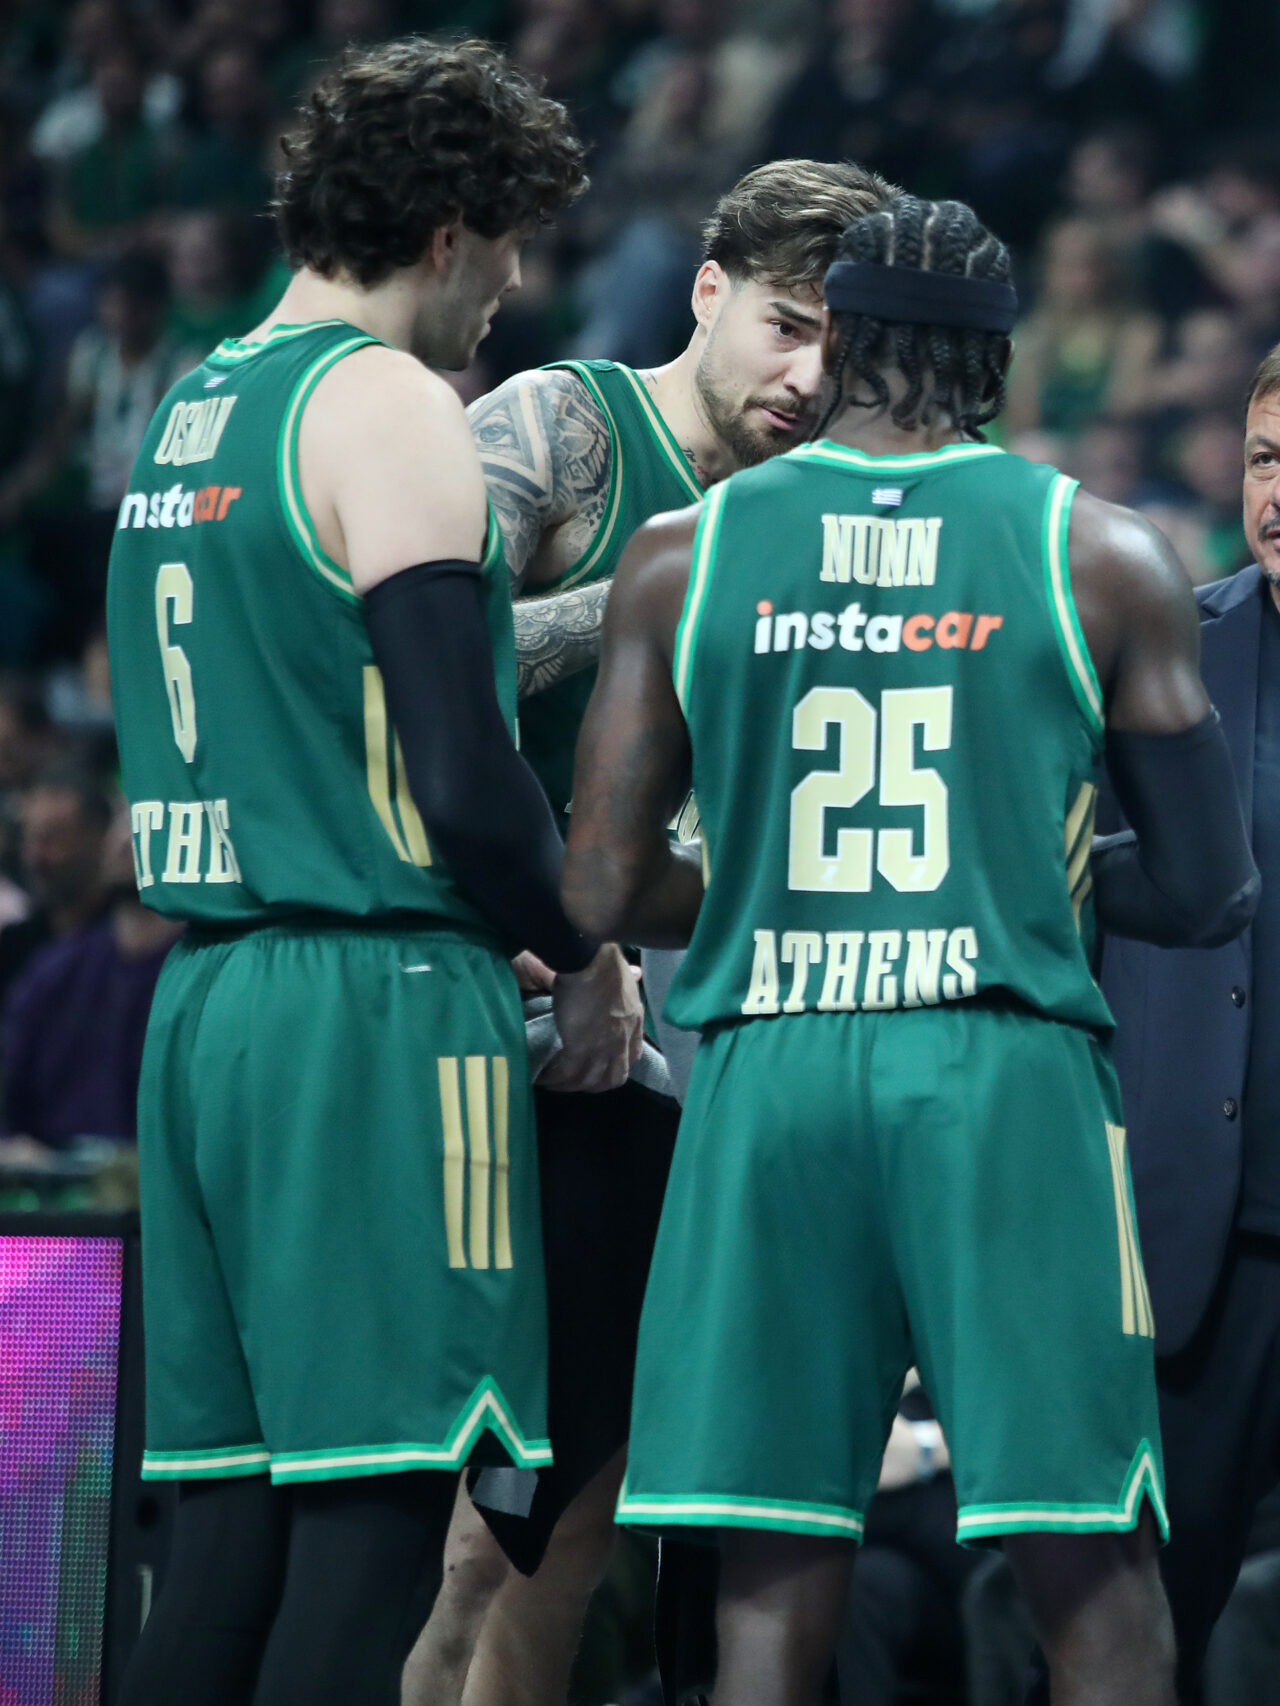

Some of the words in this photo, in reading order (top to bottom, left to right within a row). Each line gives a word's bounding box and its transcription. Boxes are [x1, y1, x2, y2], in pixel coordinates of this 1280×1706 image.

[118, 483, 242, 531] nstacar
[818, 513, 943, 587] NUNN
[154, 563, 198, 763] 6
[753, 599, 1003, 654] instacar
[787, 685, 953, 892] 25
[741, 927, 978, 1015] ATHENS
